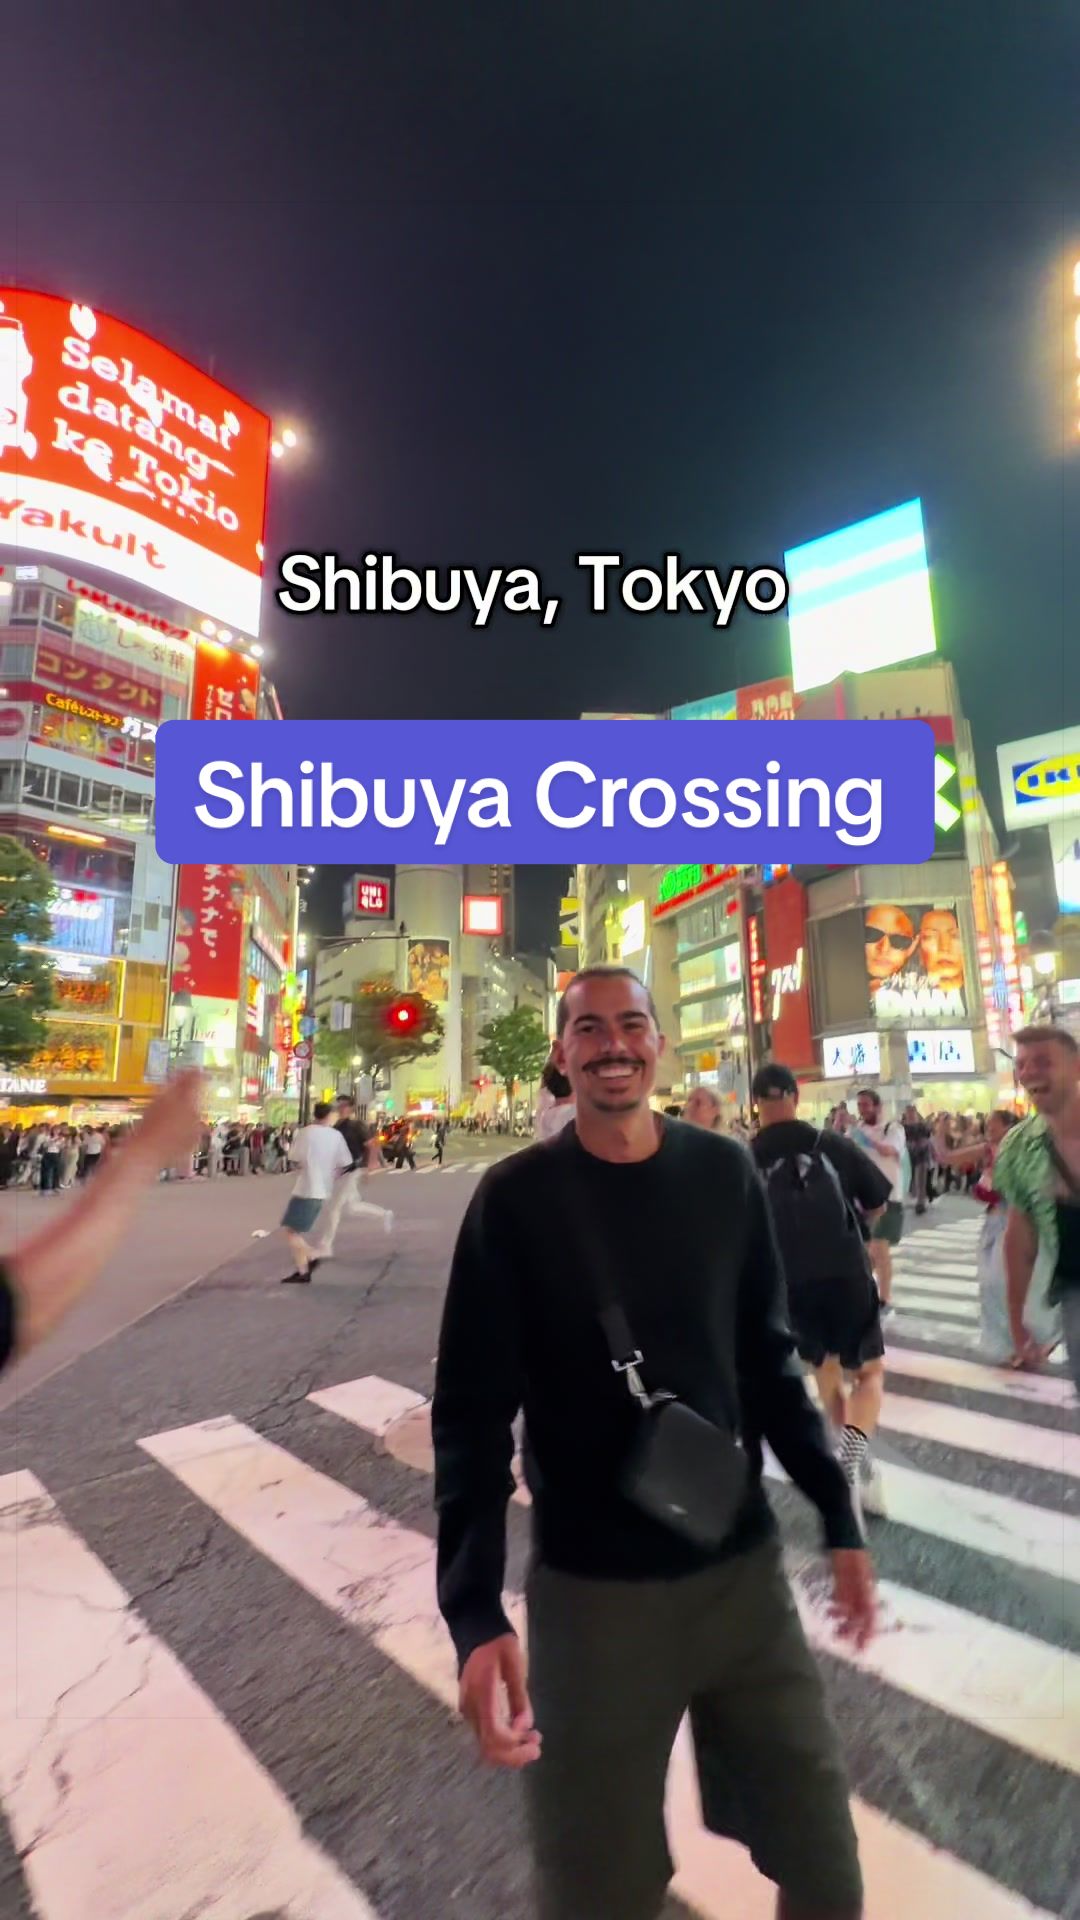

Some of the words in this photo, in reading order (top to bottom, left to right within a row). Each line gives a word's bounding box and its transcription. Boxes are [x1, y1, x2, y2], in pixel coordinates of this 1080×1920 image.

[61, 336, 236, 450] Selamat
[57, 381, 213, 480] datang
[51, 417, 113, 462] ke
[128, 445, 239, 531] Tokio
[0, 498, 167, 569] Yakult
[37, 649, 157, 708] コンタクト
[1027, 766, 1080, 788] IK
[361, 884, 382, 897] UNI
[361, 895, 383, 909] QLO
